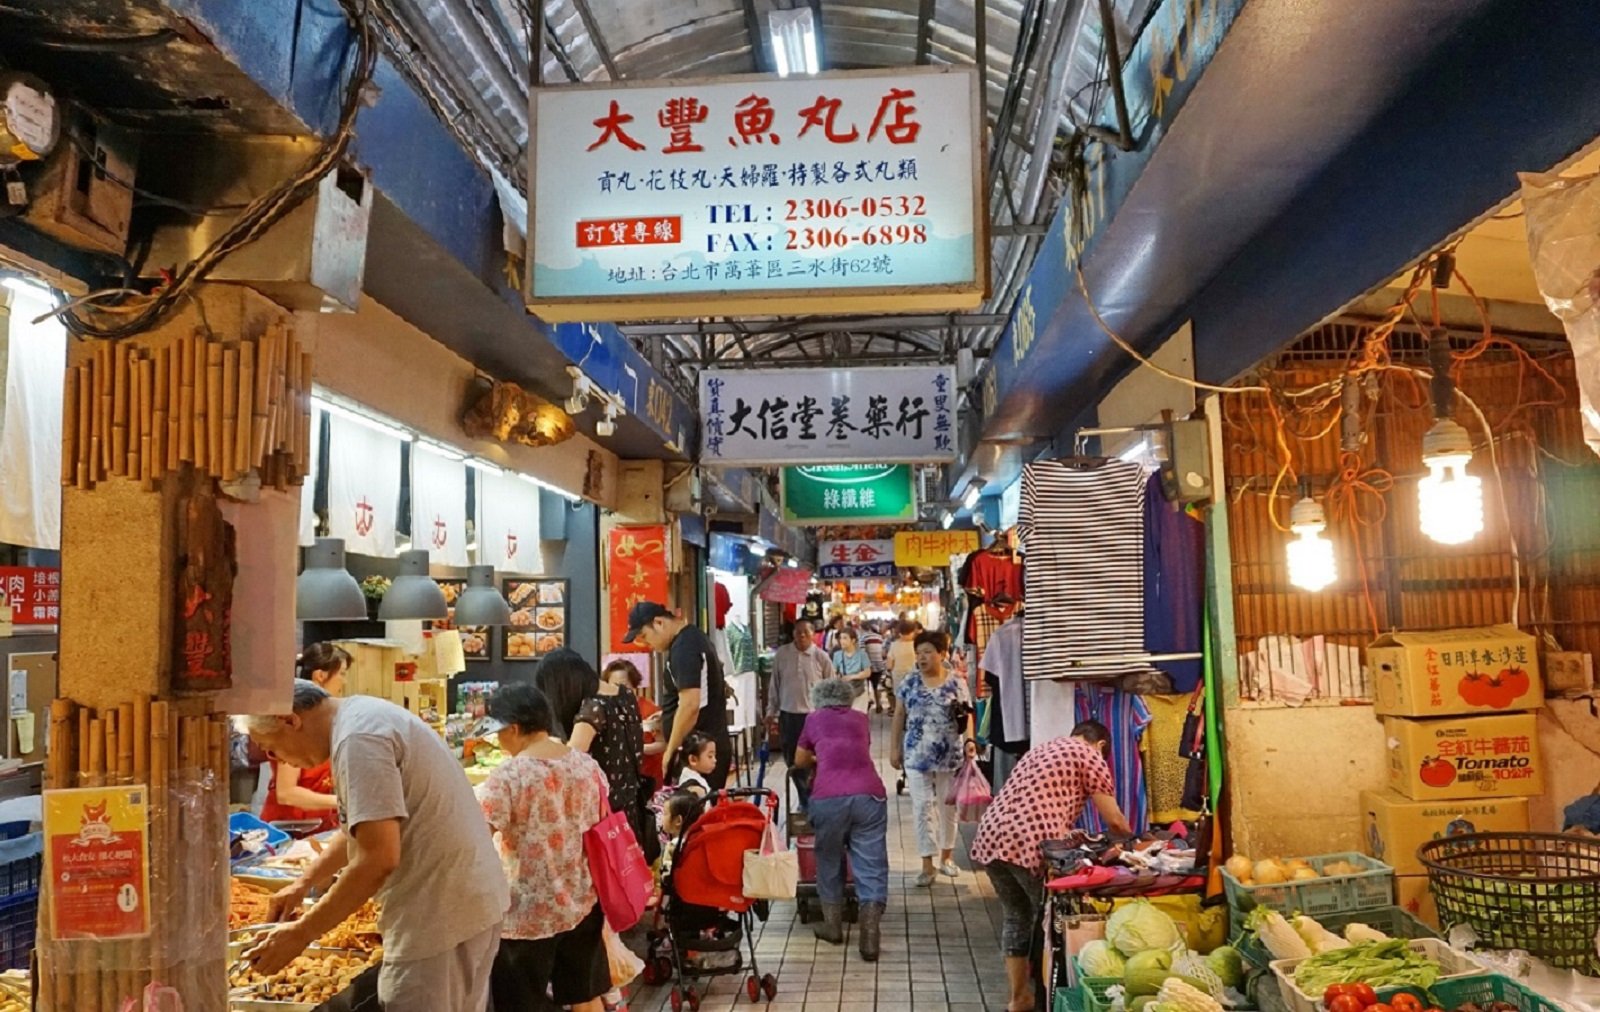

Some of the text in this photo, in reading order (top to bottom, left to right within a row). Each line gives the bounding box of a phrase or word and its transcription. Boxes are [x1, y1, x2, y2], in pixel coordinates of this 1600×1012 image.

[586, 88, 924, 155] 大豐魚丸店
[784, 195, 927, 222] 2306-0532
[583, 221, 675, 243] 訂貨專線
[784, 225, 928, 251] 2306-6898
[1455, 755, 1530, 770] Tomato
[1492, 767, 1534, 780] 10公斤
